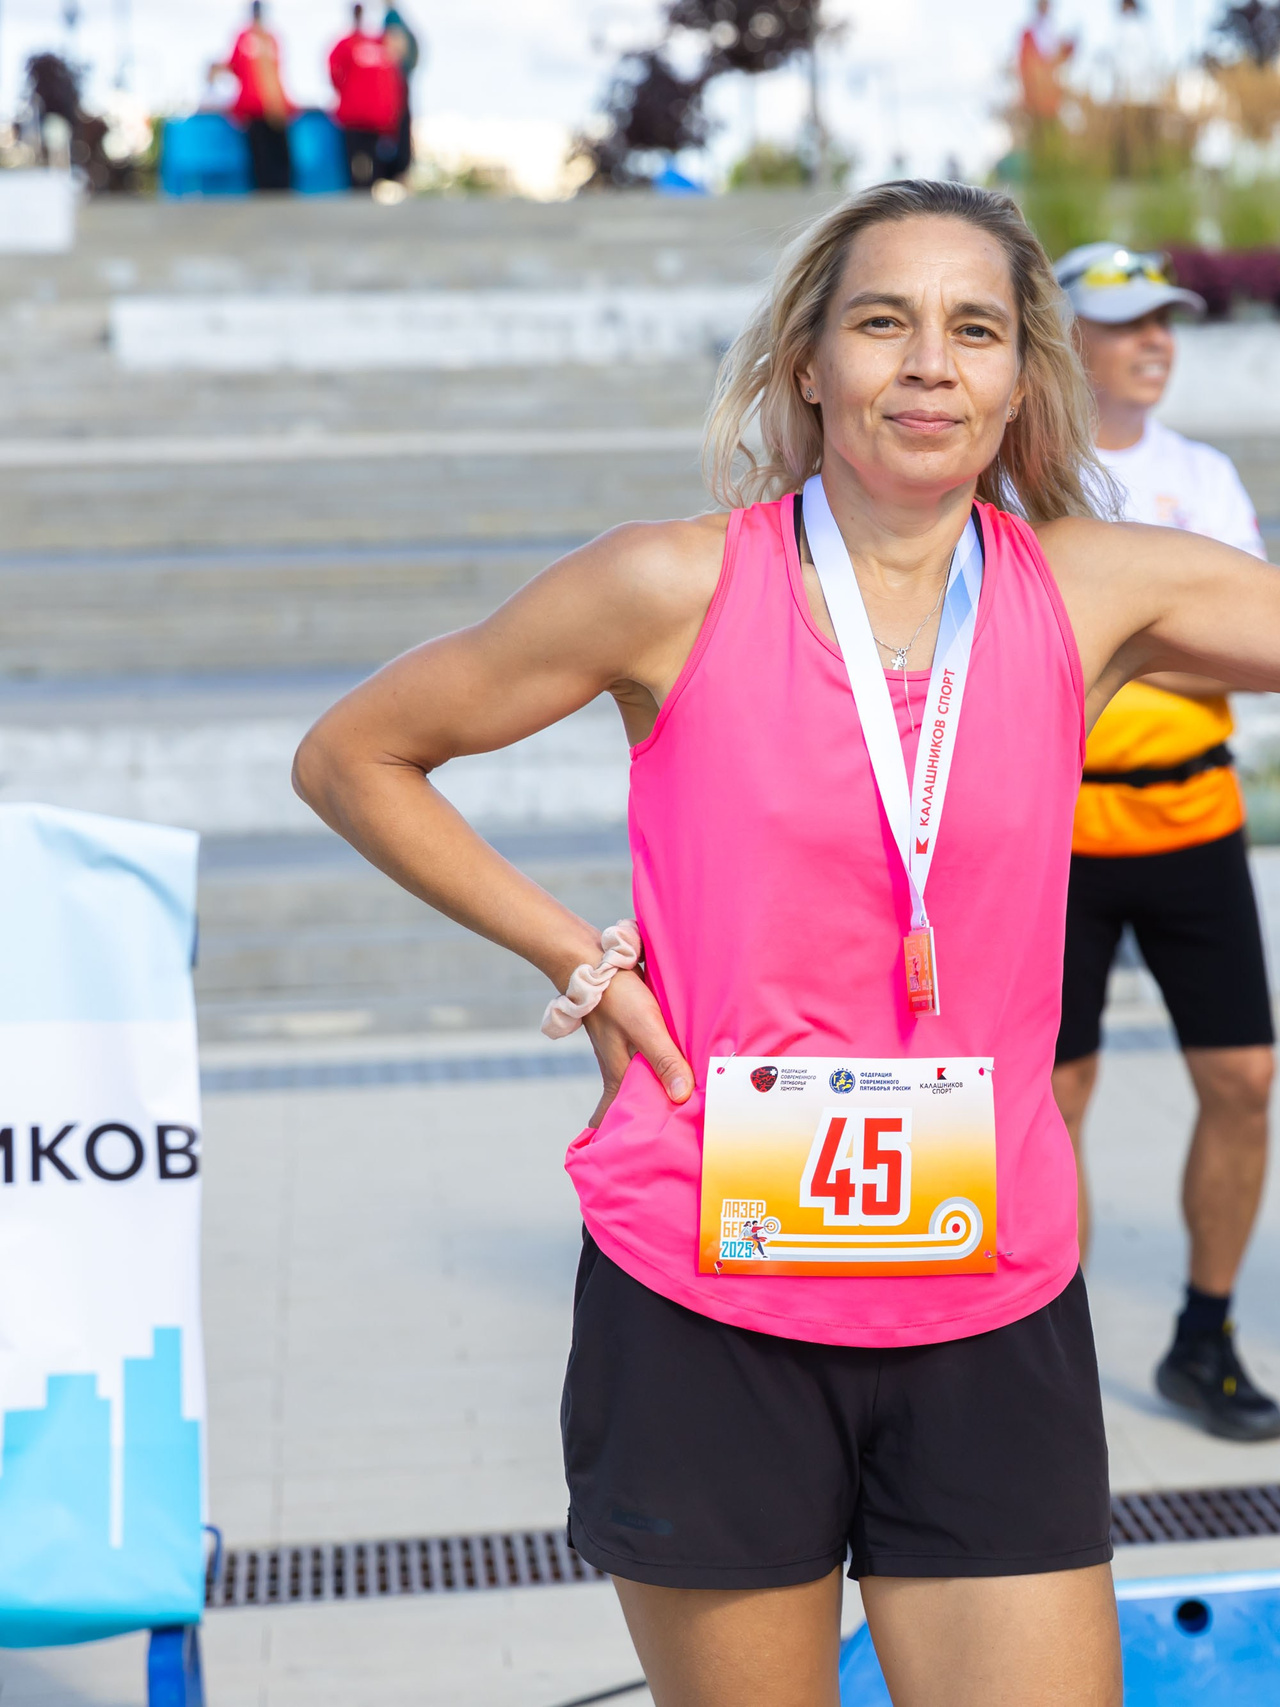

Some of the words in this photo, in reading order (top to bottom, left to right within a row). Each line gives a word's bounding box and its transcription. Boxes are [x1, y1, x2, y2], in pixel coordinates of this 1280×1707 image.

[919, 719, 946, 827] КАЛАШНИКОВ
[937, 667, 956, 715] СПОРТ
[919, 1081, 964, 1089] КАЛАШНИКОВ
[810, 1116, 903, 1216] 45
[722, 1201, 764, 1219] ЛАЗЕР
[721, 1240, 752, 1258] 2025
